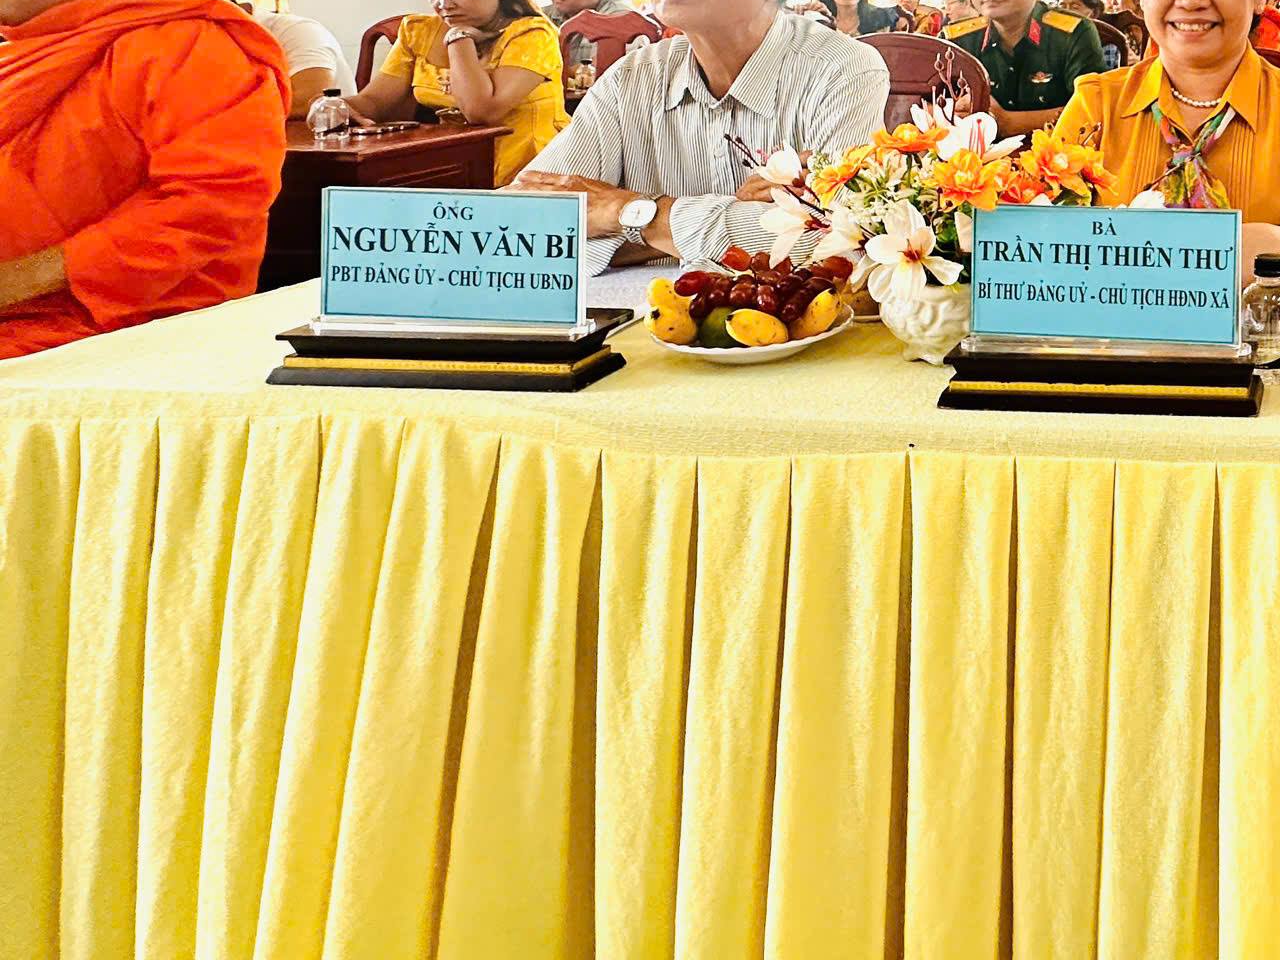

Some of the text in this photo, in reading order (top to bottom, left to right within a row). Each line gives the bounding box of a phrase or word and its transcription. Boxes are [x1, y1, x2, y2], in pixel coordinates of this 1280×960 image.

[433, 202, 474, 220] ÔNG
[332, 222, 576, 259] NGUYỄN VĂN BỈ
[1092, 218, 1117, 236] BÀ
[978, 235, 1233, 271] TRẦN THỊ THIÊN THƯ
[331, 265, 361, 282] PBT
[365, 261, 410, 284] ĐẢNG
[448, 266, 482, 287] CHỦ
[487, 271, 526, 292] TỊCH
[530, 273, 574, 291] UBND
[978, 278, 991, 299] BÍ
[994, 281, 1025, 300] THƯ
[1027, 280, 1065, 302] ĐẢNG
[1098, 283, 1128, 305] CHỦ
[1131, 288, 1165, 310] TỊCH
[1168, 289, 1207, 308] HĐND
[1211, 288, 1230, 308] XÃ
